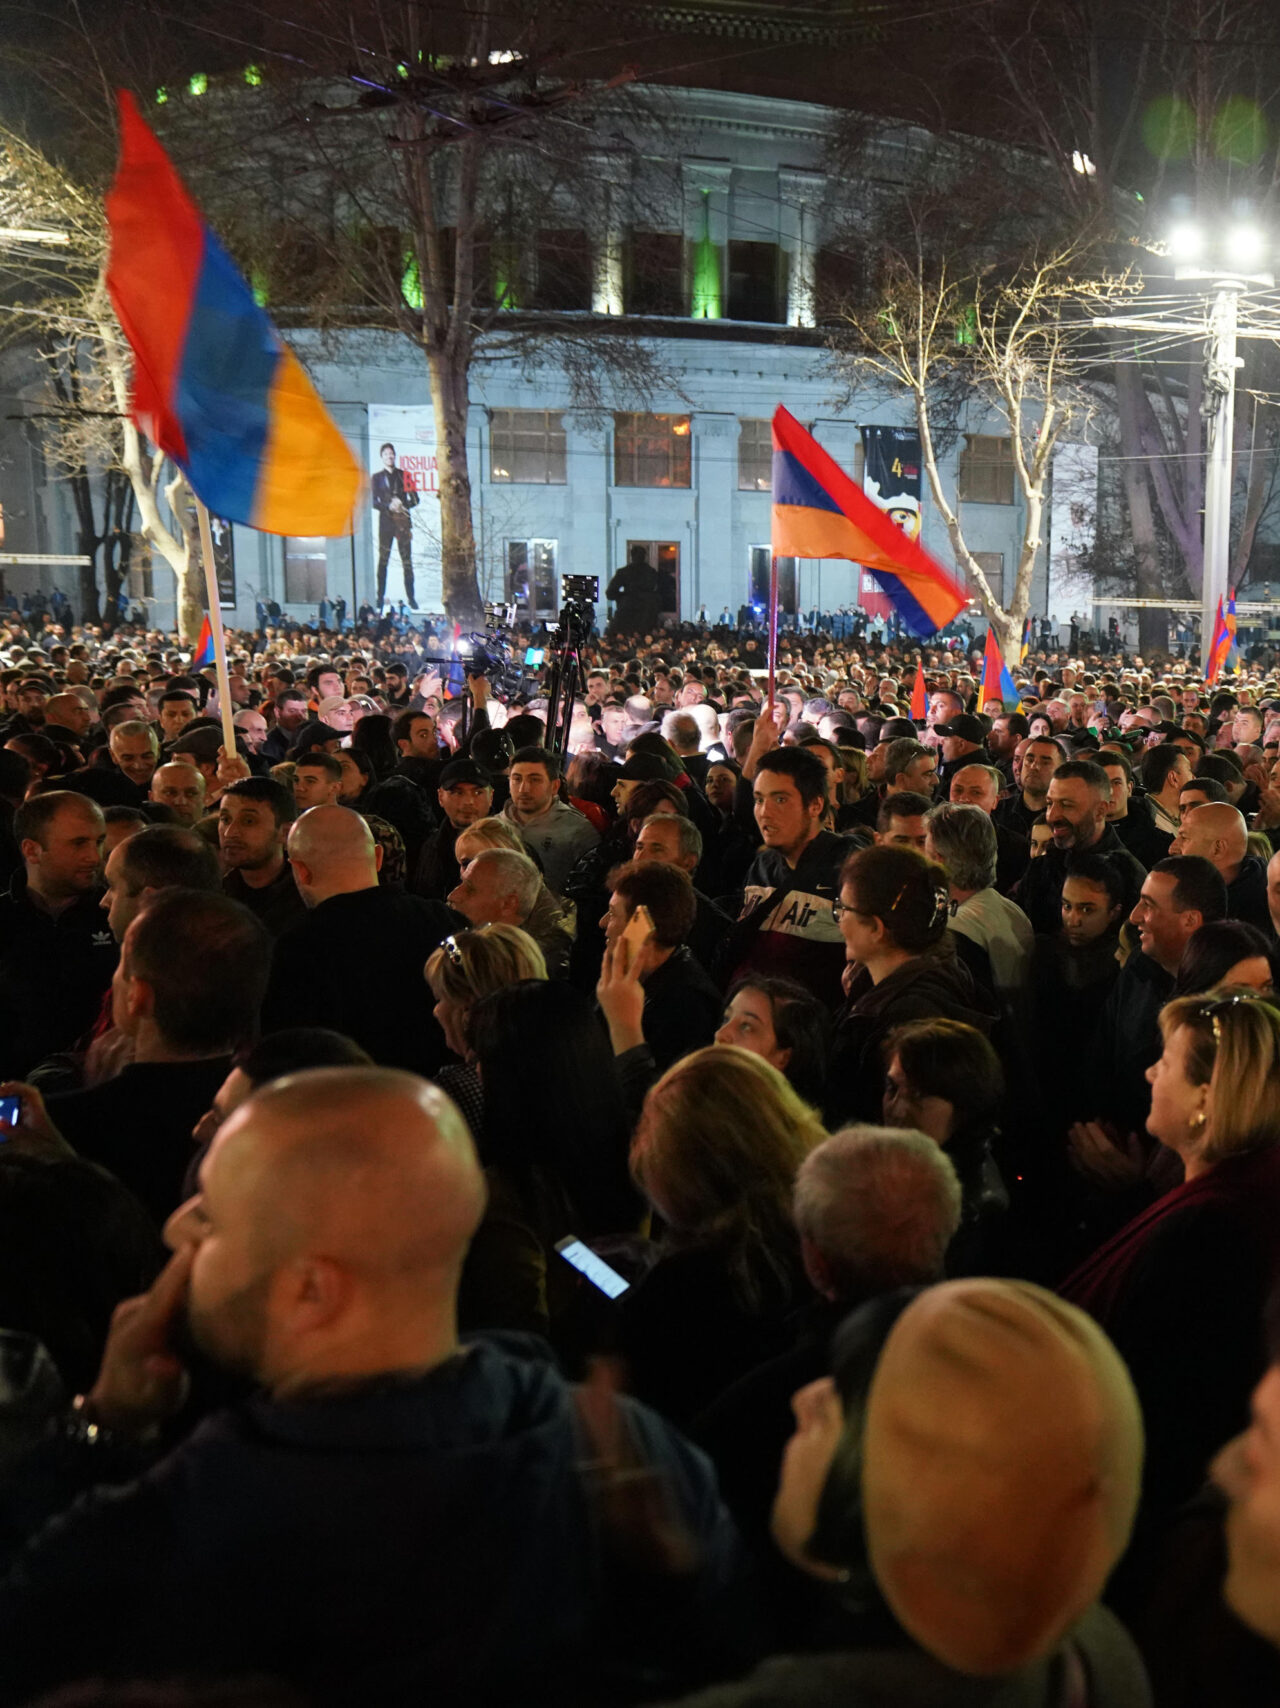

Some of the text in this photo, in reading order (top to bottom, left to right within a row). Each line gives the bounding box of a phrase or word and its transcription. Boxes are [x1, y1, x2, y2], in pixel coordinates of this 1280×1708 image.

[891, 457, 902, 478] 4
[403, 471, 440, 492] BELL
[781, 900, 817, 927] Air
